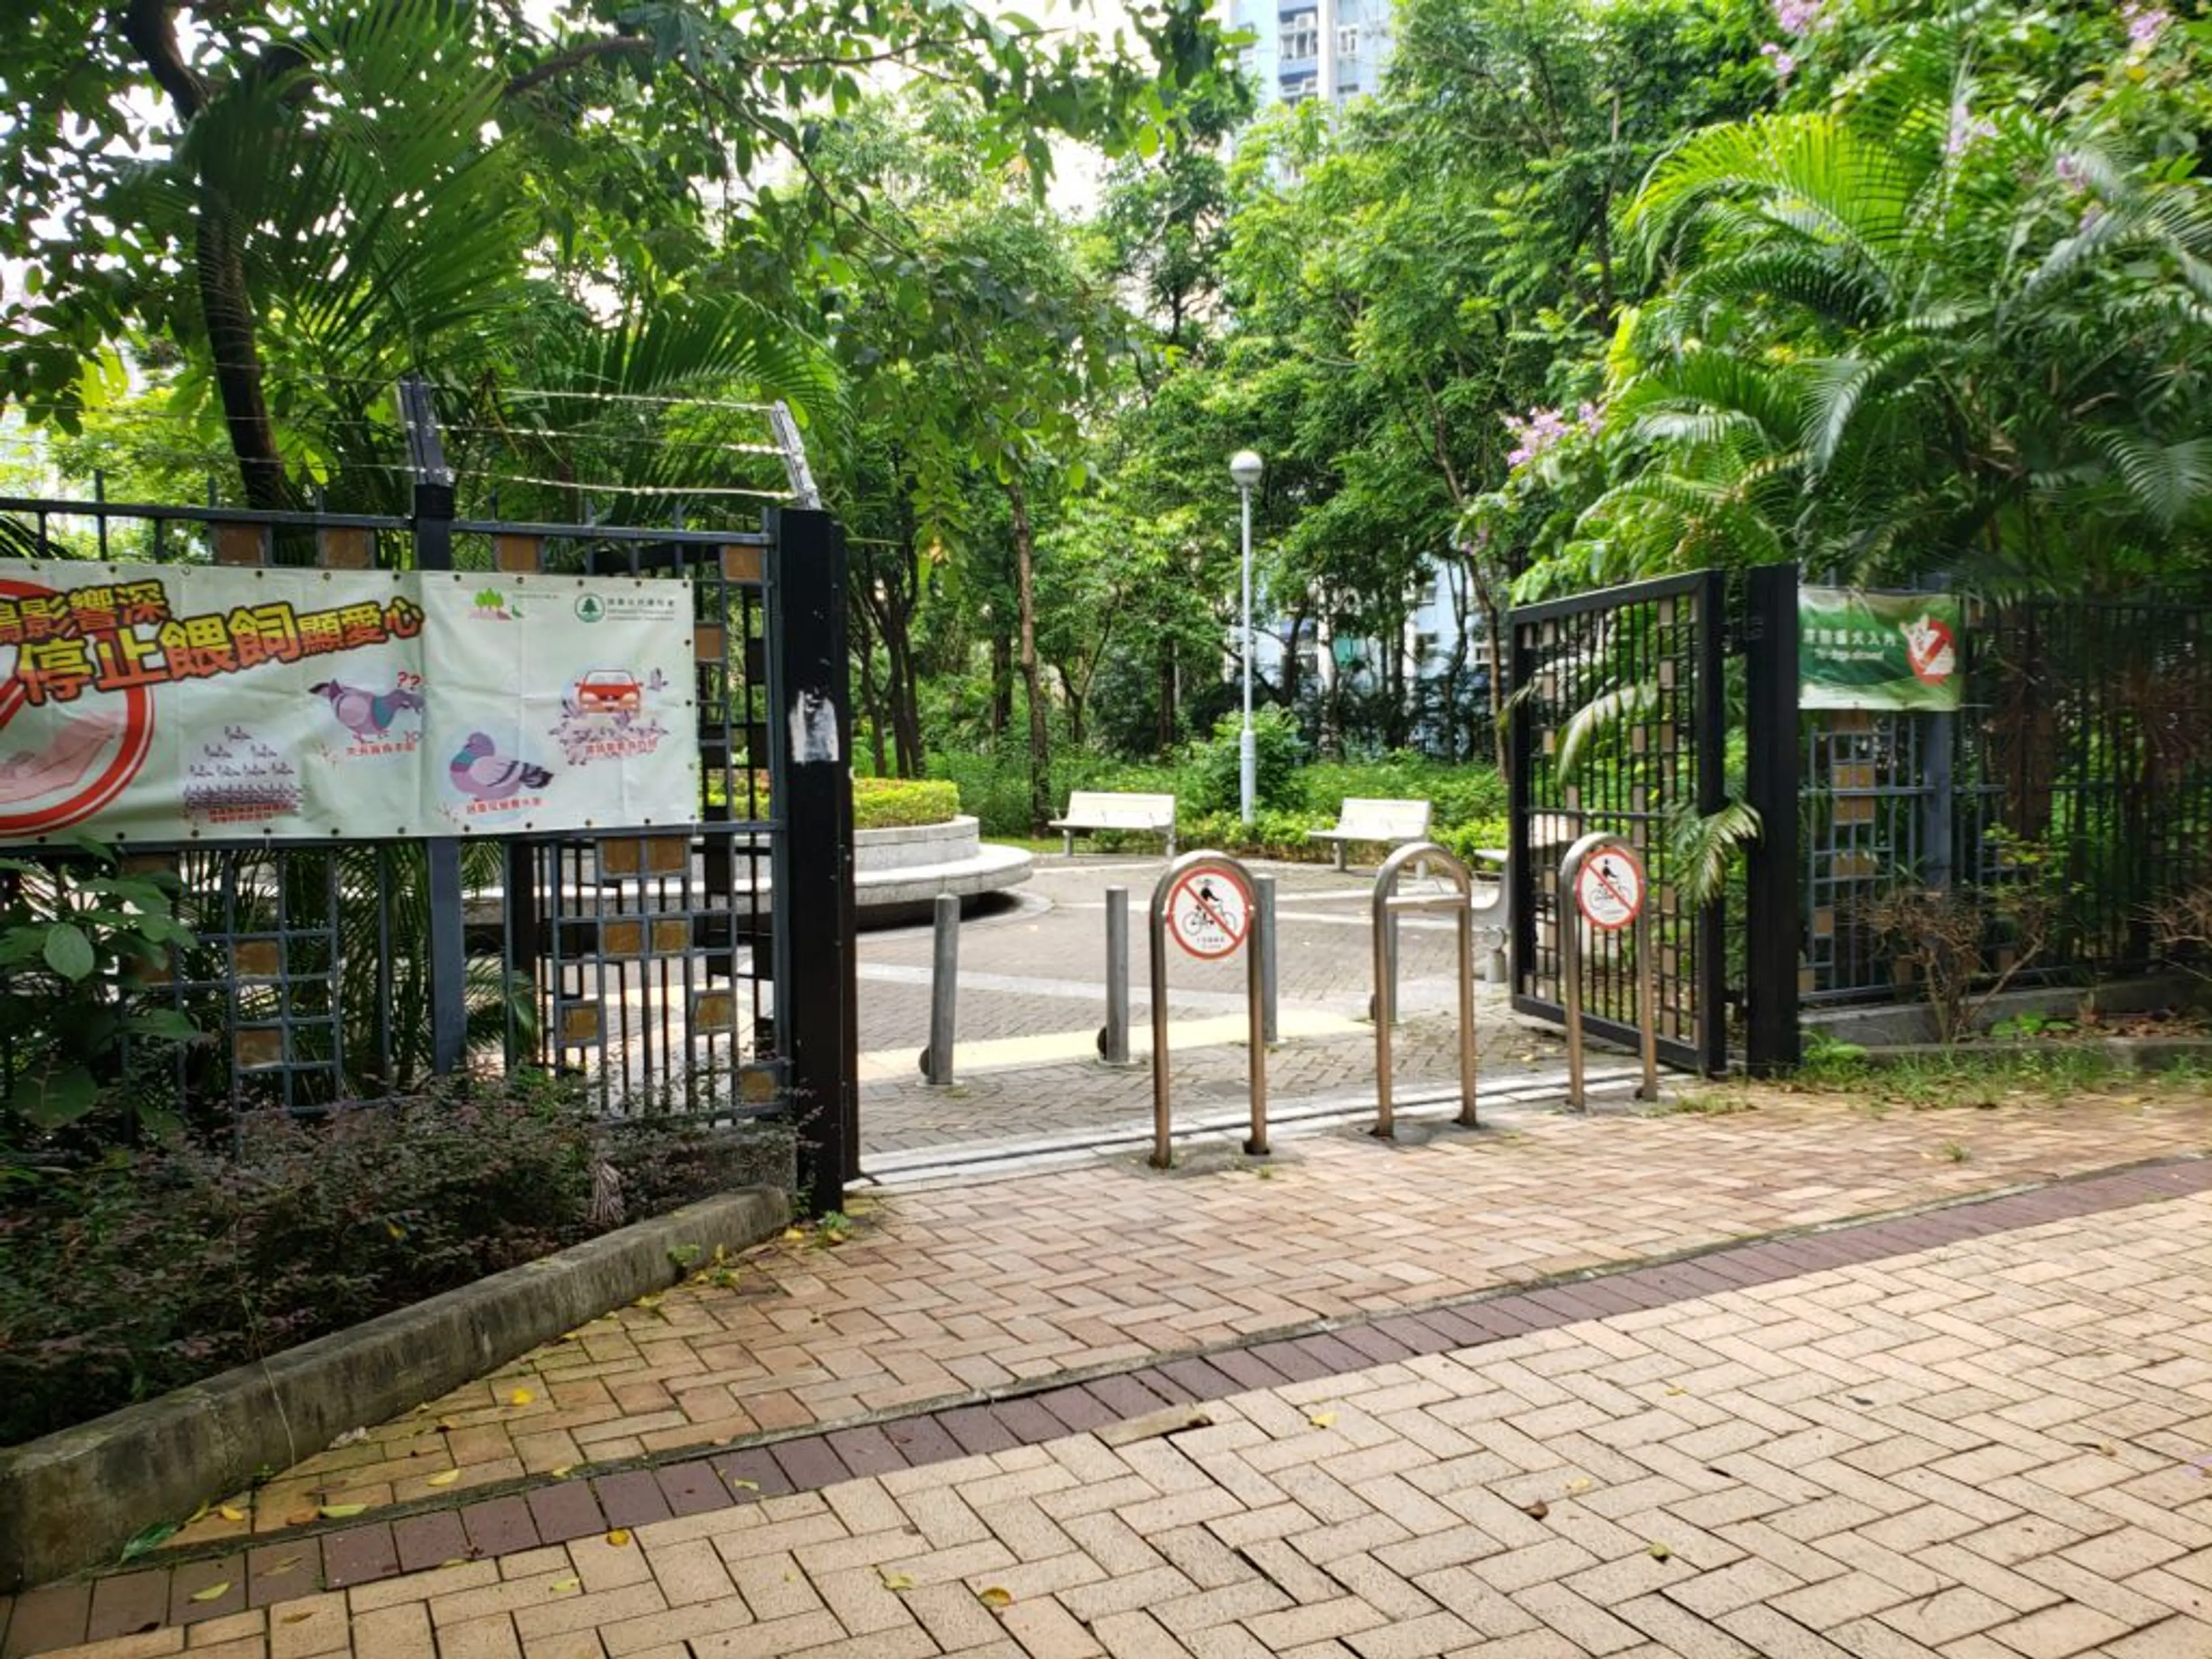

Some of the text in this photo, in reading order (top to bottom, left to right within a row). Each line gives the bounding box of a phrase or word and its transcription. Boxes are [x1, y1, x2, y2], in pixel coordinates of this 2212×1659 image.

[15, 597, 424, 706] 停止餵飼顯愛心
